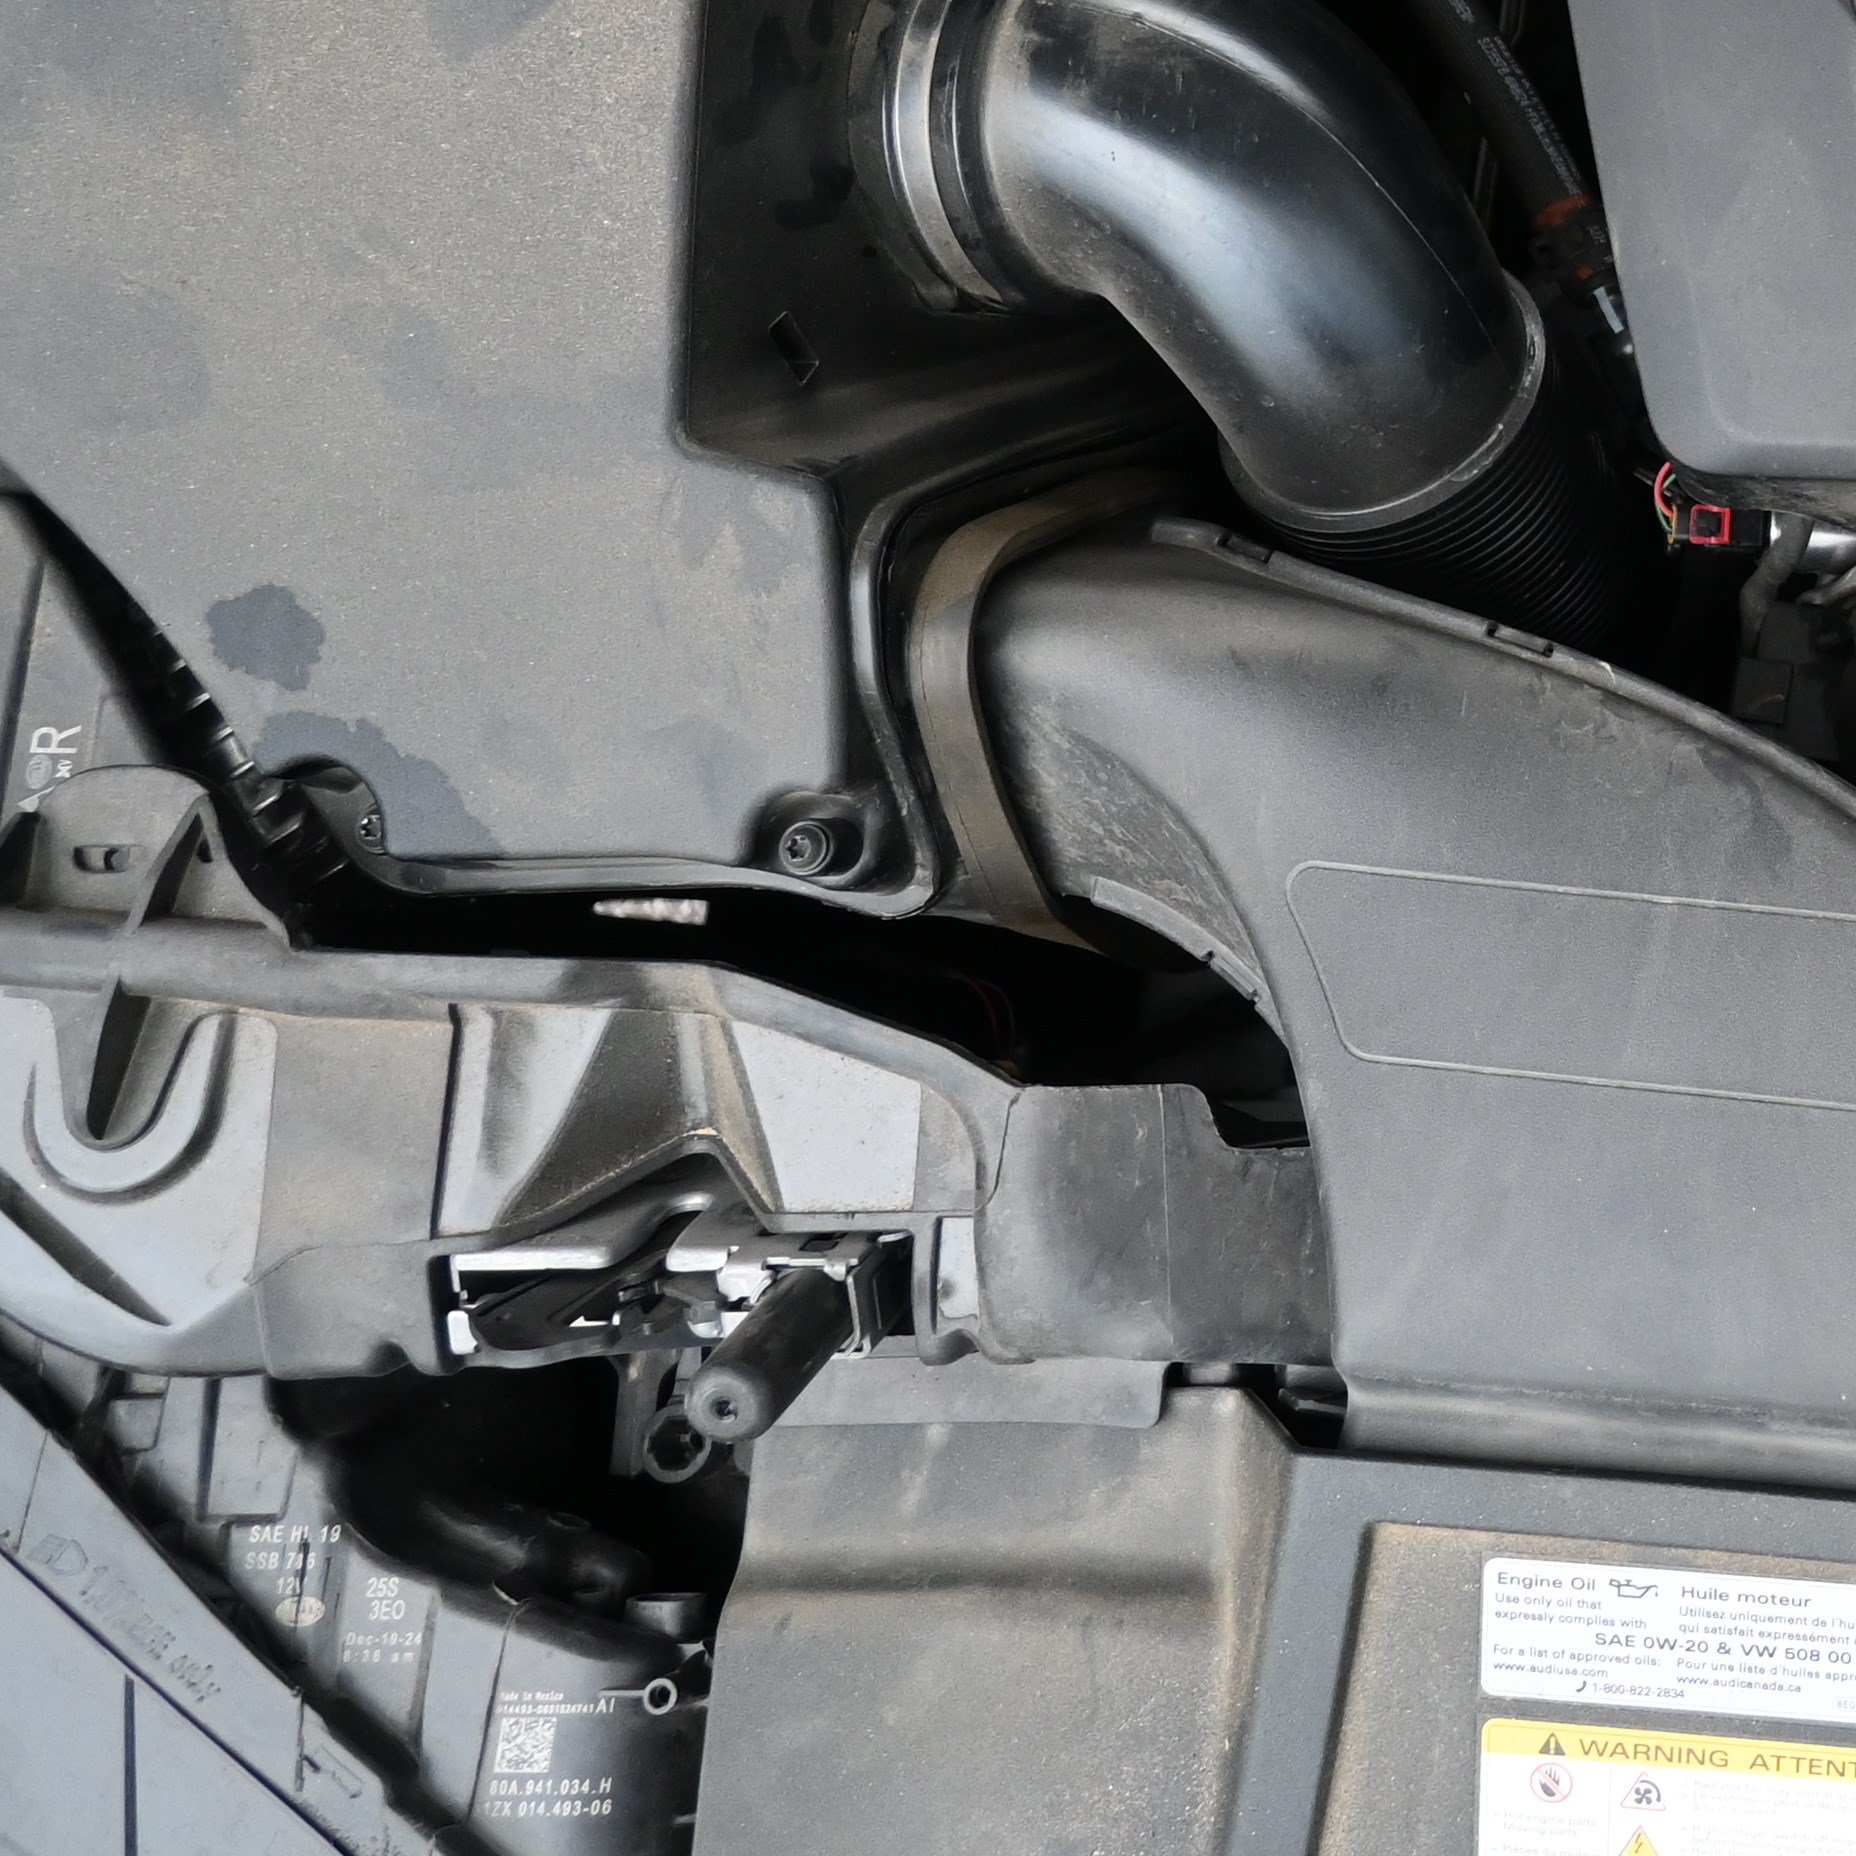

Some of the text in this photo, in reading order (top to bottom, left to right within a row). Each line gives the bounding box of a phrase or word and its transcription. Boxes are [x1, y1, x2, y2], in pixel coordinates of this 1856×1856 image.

[29, 725, 82, 753] R
[249, 1524, 284, 1543] SAE
[320, 1524, 342, 1542] 19
[244, 1552, 279, 1569] SSB
[366, 1577, 399, 1598] 25S
[1497, 1572, 1596, 1591] Engine Oil
[1495, 1592, 1602, 1610] Use only oil that
[1681, 1586, 1812, 1607] Huile moteur
[1494, 1609, 1647, 1629] expressly complies with
[1679, 1605, 1726, 1620] Utilisez
[1730, 1611, 1808, 1626] uniquement
[1811, 1616, 1827, 1627] de
[1678, 1623, 1700, 1635] qui
[1703, 1624, 1754, 1638] satisfait
[1758, 1630, 1850, 1645] expressément
[1493, 1644, 1661, 1666] For a list of approved oils:
[1594, 1632, 1852, 1664] SAE 0W-20 & VW 508 00
[1493, 1661, 1609, 1678] www.audiusa.com
[1676, 1658, 1707, 1670] Pour
[1711, 1663, 1734, 1672] une
[1739, 1662, 1765, 1674] liste
[1592, 1683, 1685, 1699] 1-800-822-2834
[1676, 1675, 1801, 1693] www.audicanada.ca
[535, 1691, 564, 1701] Mexico
[1579, 1738, 1729, 1768] WARNING
[489, 1777, 612, 1795] 80A.941.034.H
[518, 1799, 612, 1817] 014.493-06
